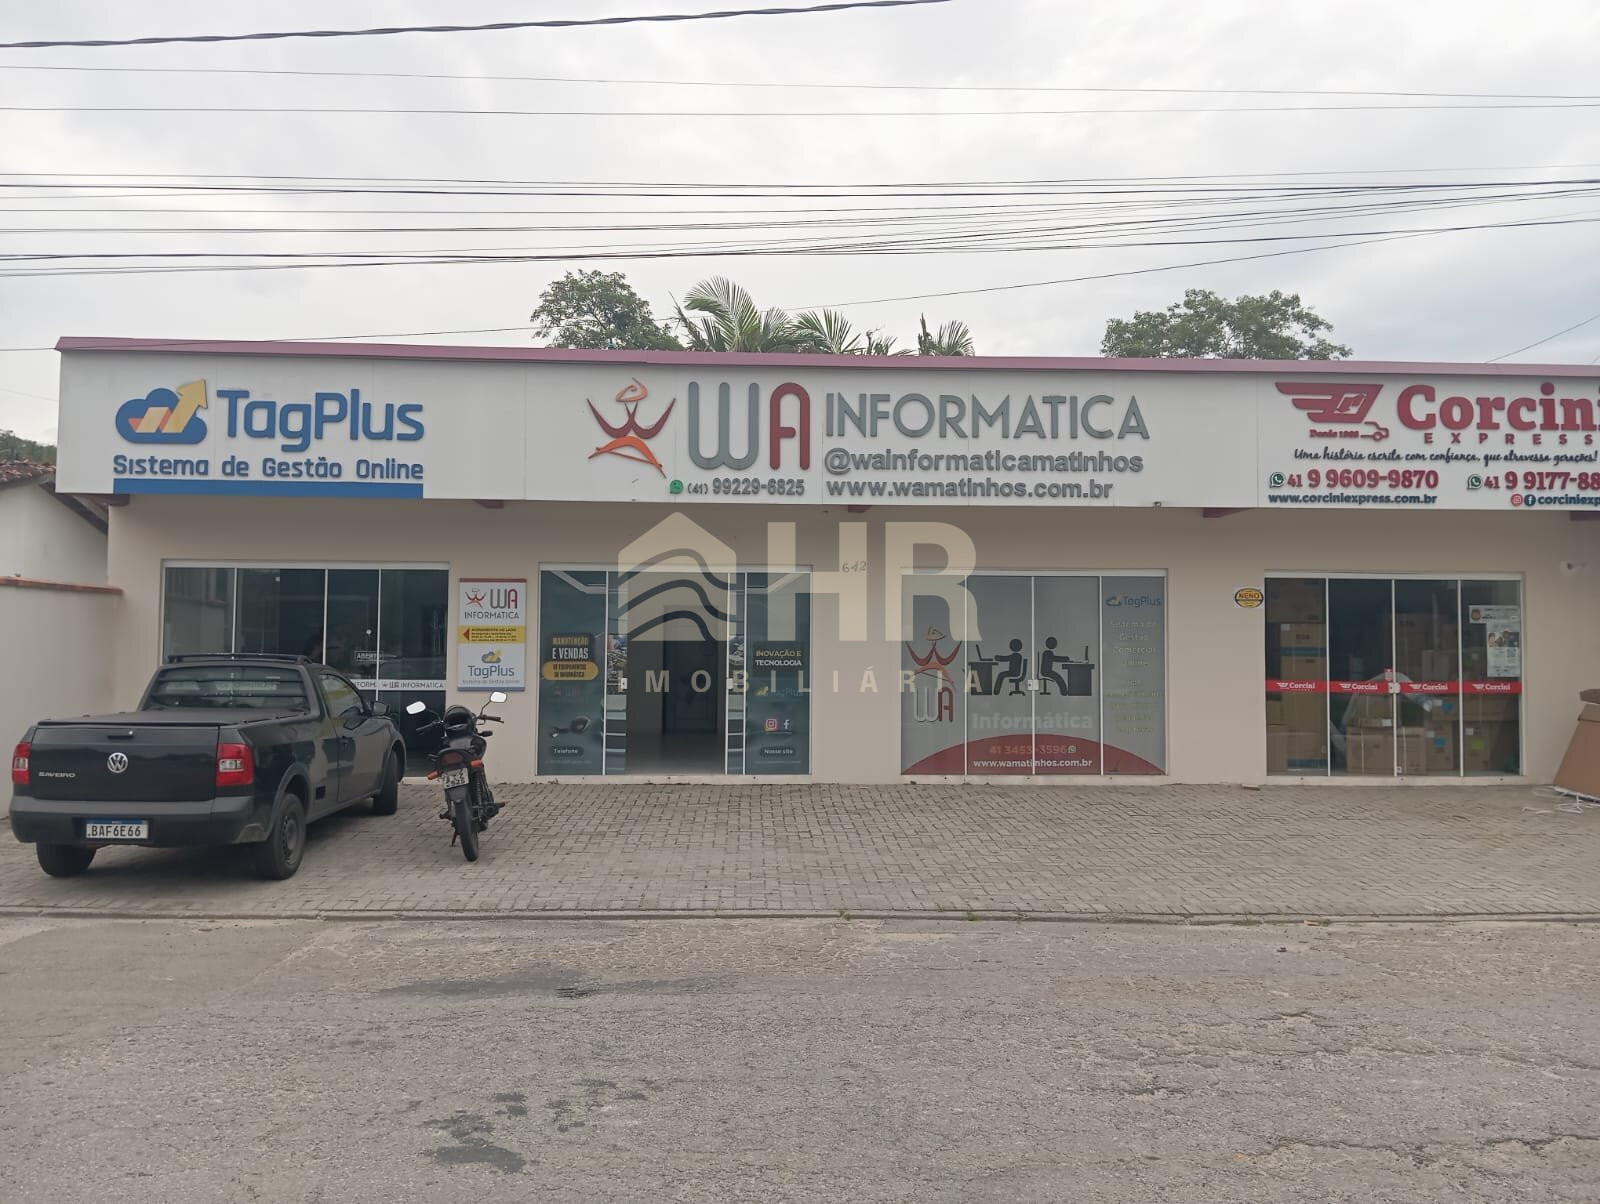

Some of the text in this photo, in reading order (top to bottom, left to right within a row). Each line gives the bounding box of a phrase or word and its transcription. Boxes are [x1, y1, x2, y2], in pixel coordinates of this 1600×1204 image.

[1397, 382, 1600, 431] Corcin
[216, 389, 425, 452] TagPlus
[688, 381, 810, 470] WA
[825, 393, 1151, 440] INFORMATICA
[1424, 432, 1594, 445] EXPRESS
[825, 447, 1144, 475] @wainformaticamatinhos
[1294, 449, 1321, 460] Uma
[1323, 446, 1365, 460] história
[1368, 449, 1403, 460] escrita
[1405, 453, 1427, 461] com
[1483, 455, 1502, 467] que
[1503, 450, 1551, 462] atravessa
[113, 455, 424, 480] Sistema de Gestão Online
[687, 477, 805, 496] (41) 99229-6825
[827, 477, 1113, 499] www.wamatinhos.com.br
[1287, 469, 1440, 489] 41 9 9609-9870
[1484, 476, 1500, 489] 41
[1504, 471, 1518, 490] 9
[1268, 493, 1438, 505] www.corciniexpress.com.br
[490, 588, 518, 609] WA
[1123, 595, 1161, 607] TagPlus
[464, 611, 520, 620] INFORMATICA
[552, 647, 589, 660] E VENDAS
[756, 648, 796, 658] INOVAÇÃO
[467, 665, 515, 679] TagPlus
[972, 711, 1093, 730] Informática
[973, 759, 1093, 768] www.wamatinhos.com.br
[91, 825, 141, 837] BAF6E66
